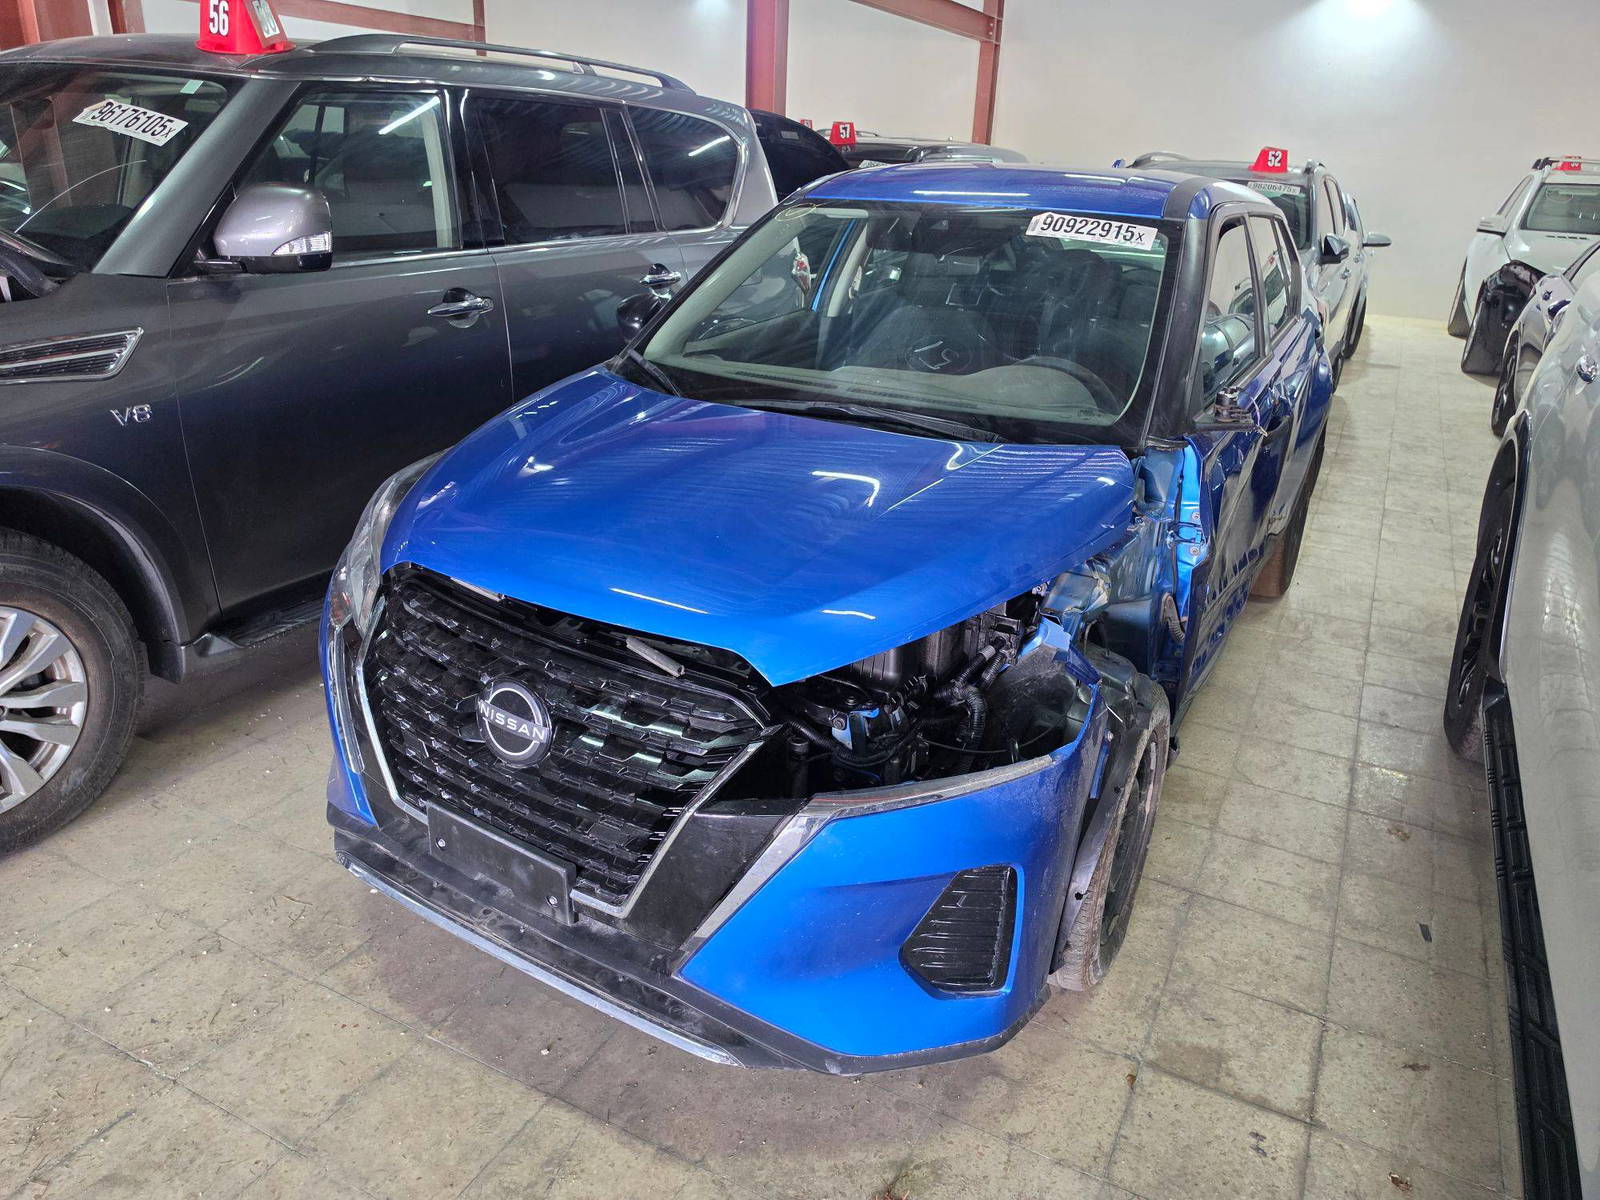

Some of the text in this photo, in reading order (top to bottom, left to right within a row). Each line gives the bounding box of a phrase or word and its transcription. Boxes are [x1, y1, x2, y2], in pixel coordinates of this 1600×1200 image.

[209, 0, 229, 36] 56
[839, 123, 851, 139] 57
[1267, 150, 1282, 167] 52
[480, 701, 545, 740] NISSAN
